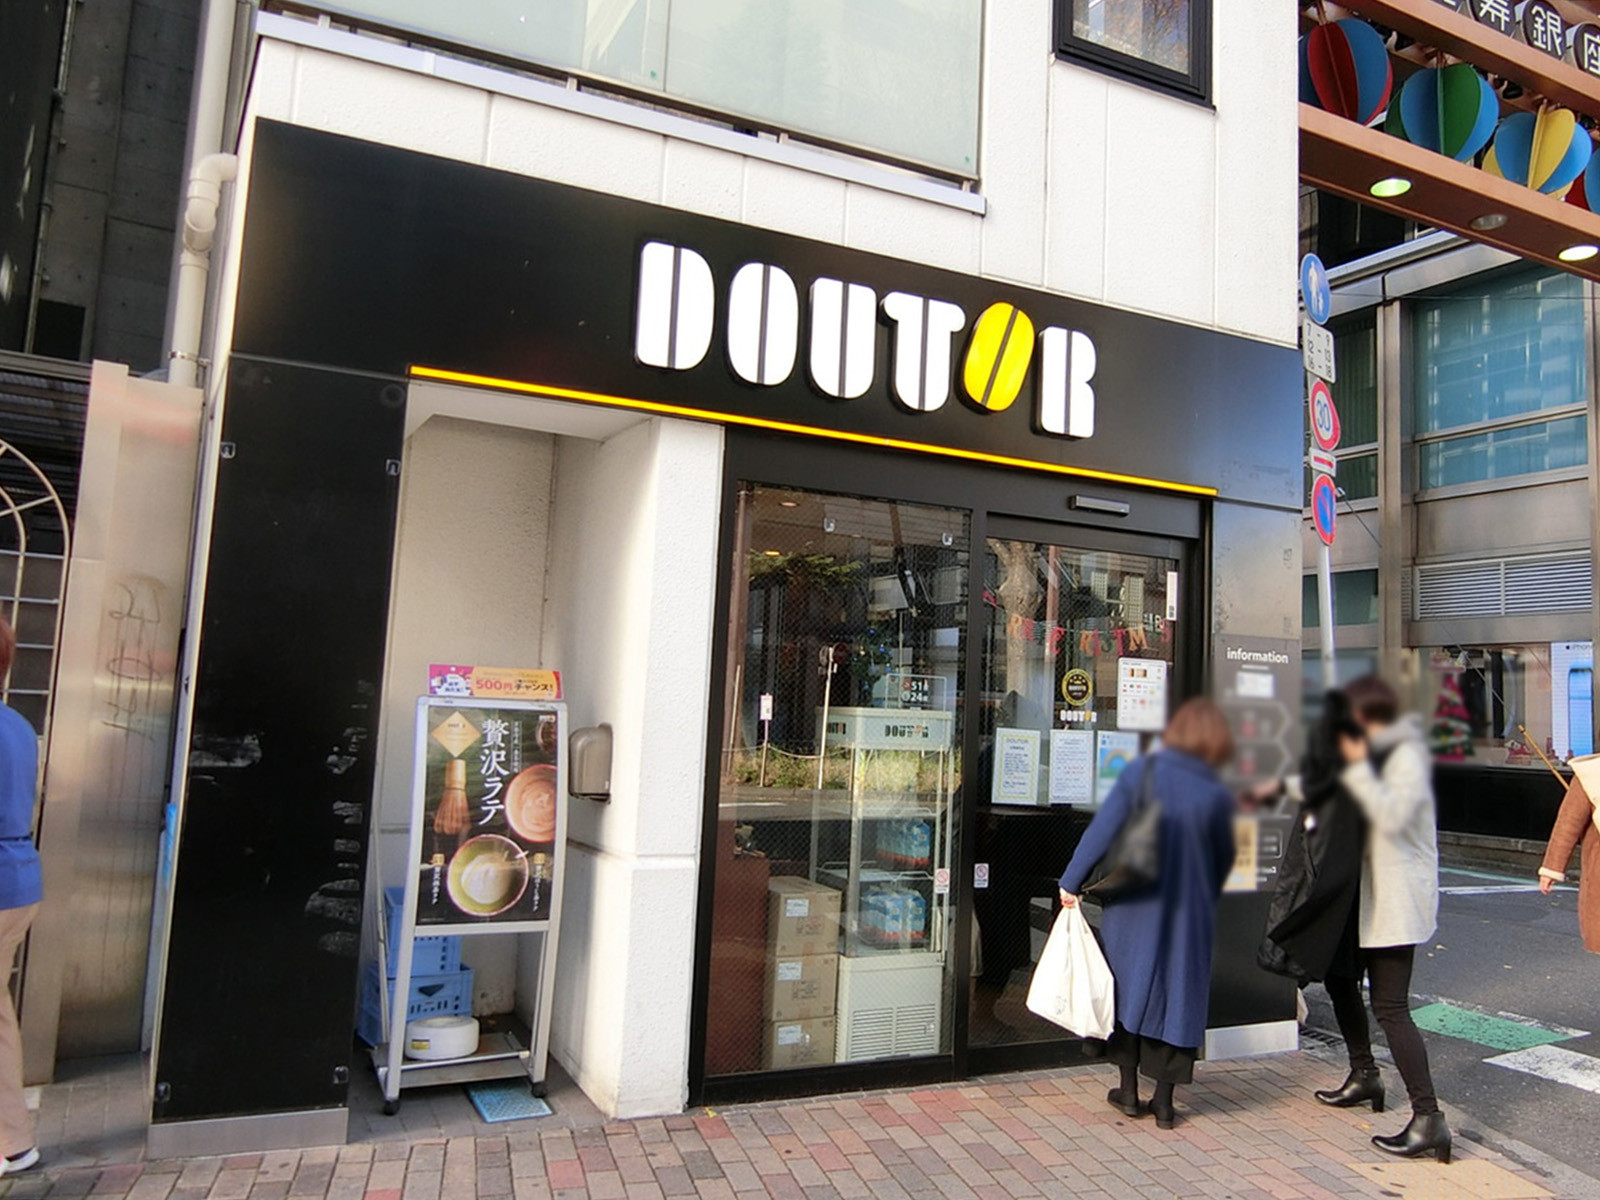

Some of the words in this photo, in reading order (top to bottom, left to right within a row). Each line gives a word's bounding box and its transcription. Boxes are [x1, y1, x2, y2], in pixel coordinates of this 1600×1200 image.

[1443, 0, 1600, 76] 寿銀座
[635, 241, 1097, 439] DOUTOR
[1316, 399, 1331, 432] 30
[1226, 647, 1289, 664] information
[1059, 709, 1098, 723] DOUTOR
[479, 718, 511, 826] 贅沢ラテ
